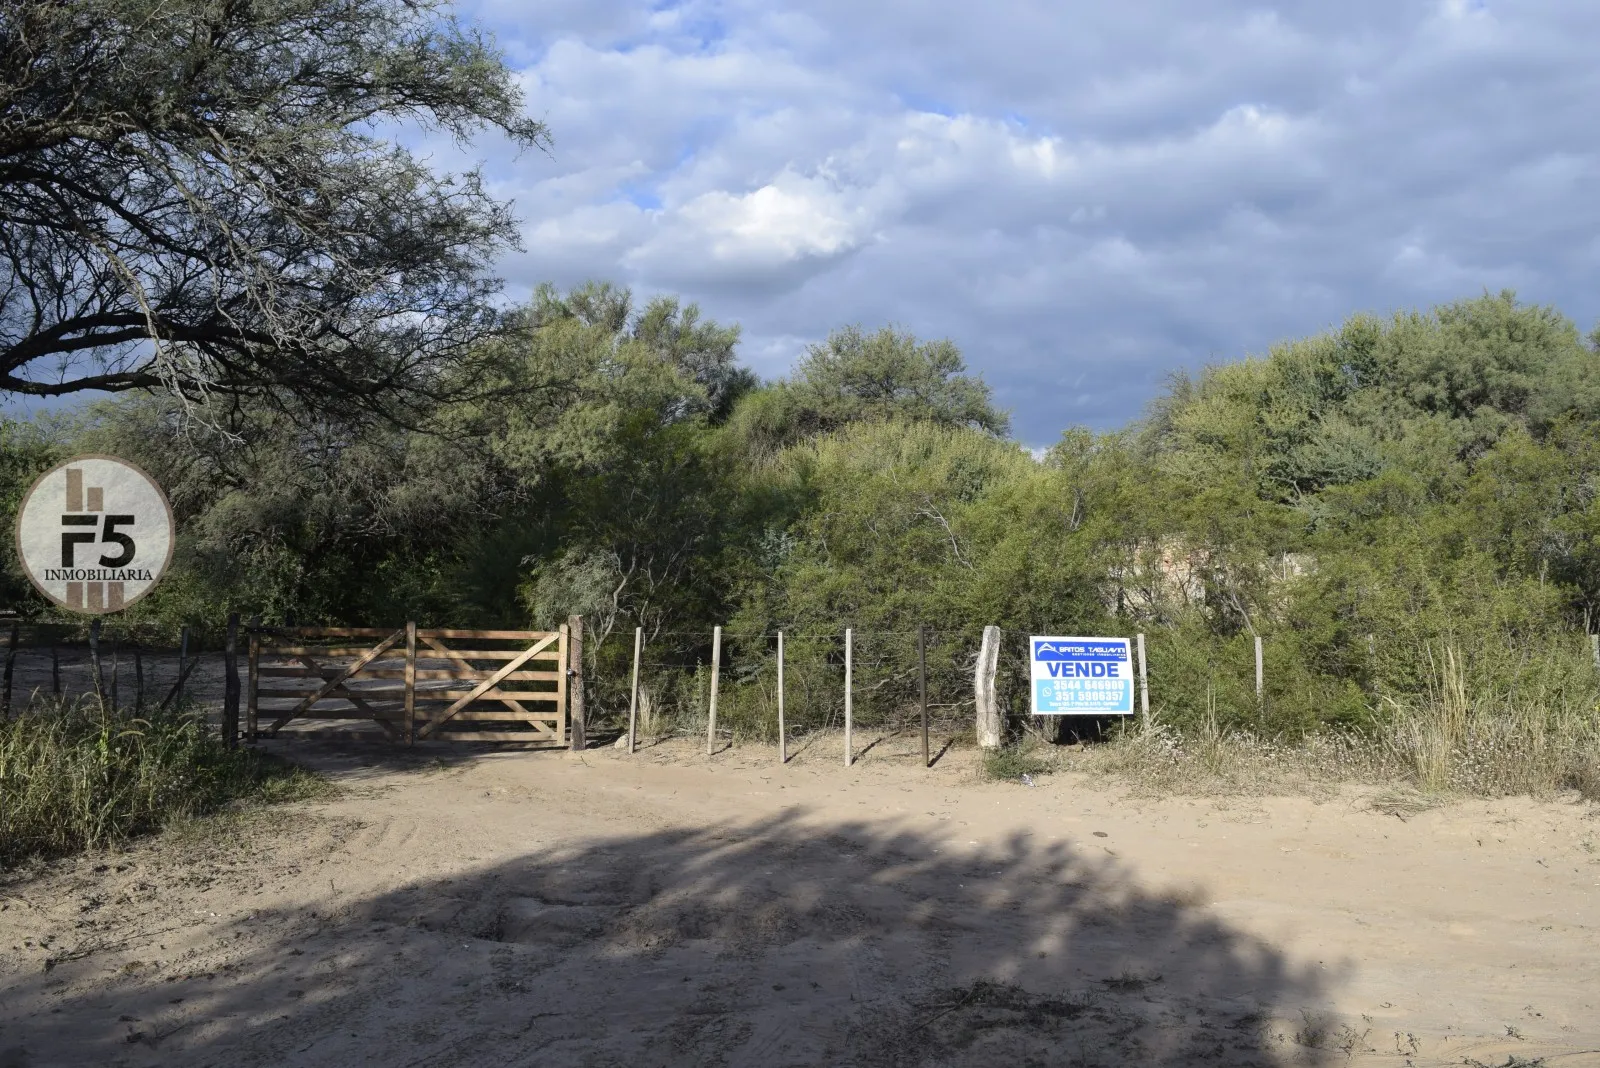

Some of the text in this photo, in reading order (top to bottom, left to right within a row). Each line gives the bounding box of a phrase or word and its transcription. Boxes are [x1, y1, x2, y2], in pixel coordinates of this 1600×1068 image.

[1046, 662, 1119, 677] VENDE
[1053, 680, 1081, 690] 3544
[1055, 691, 1124, 701] 351 5906357
